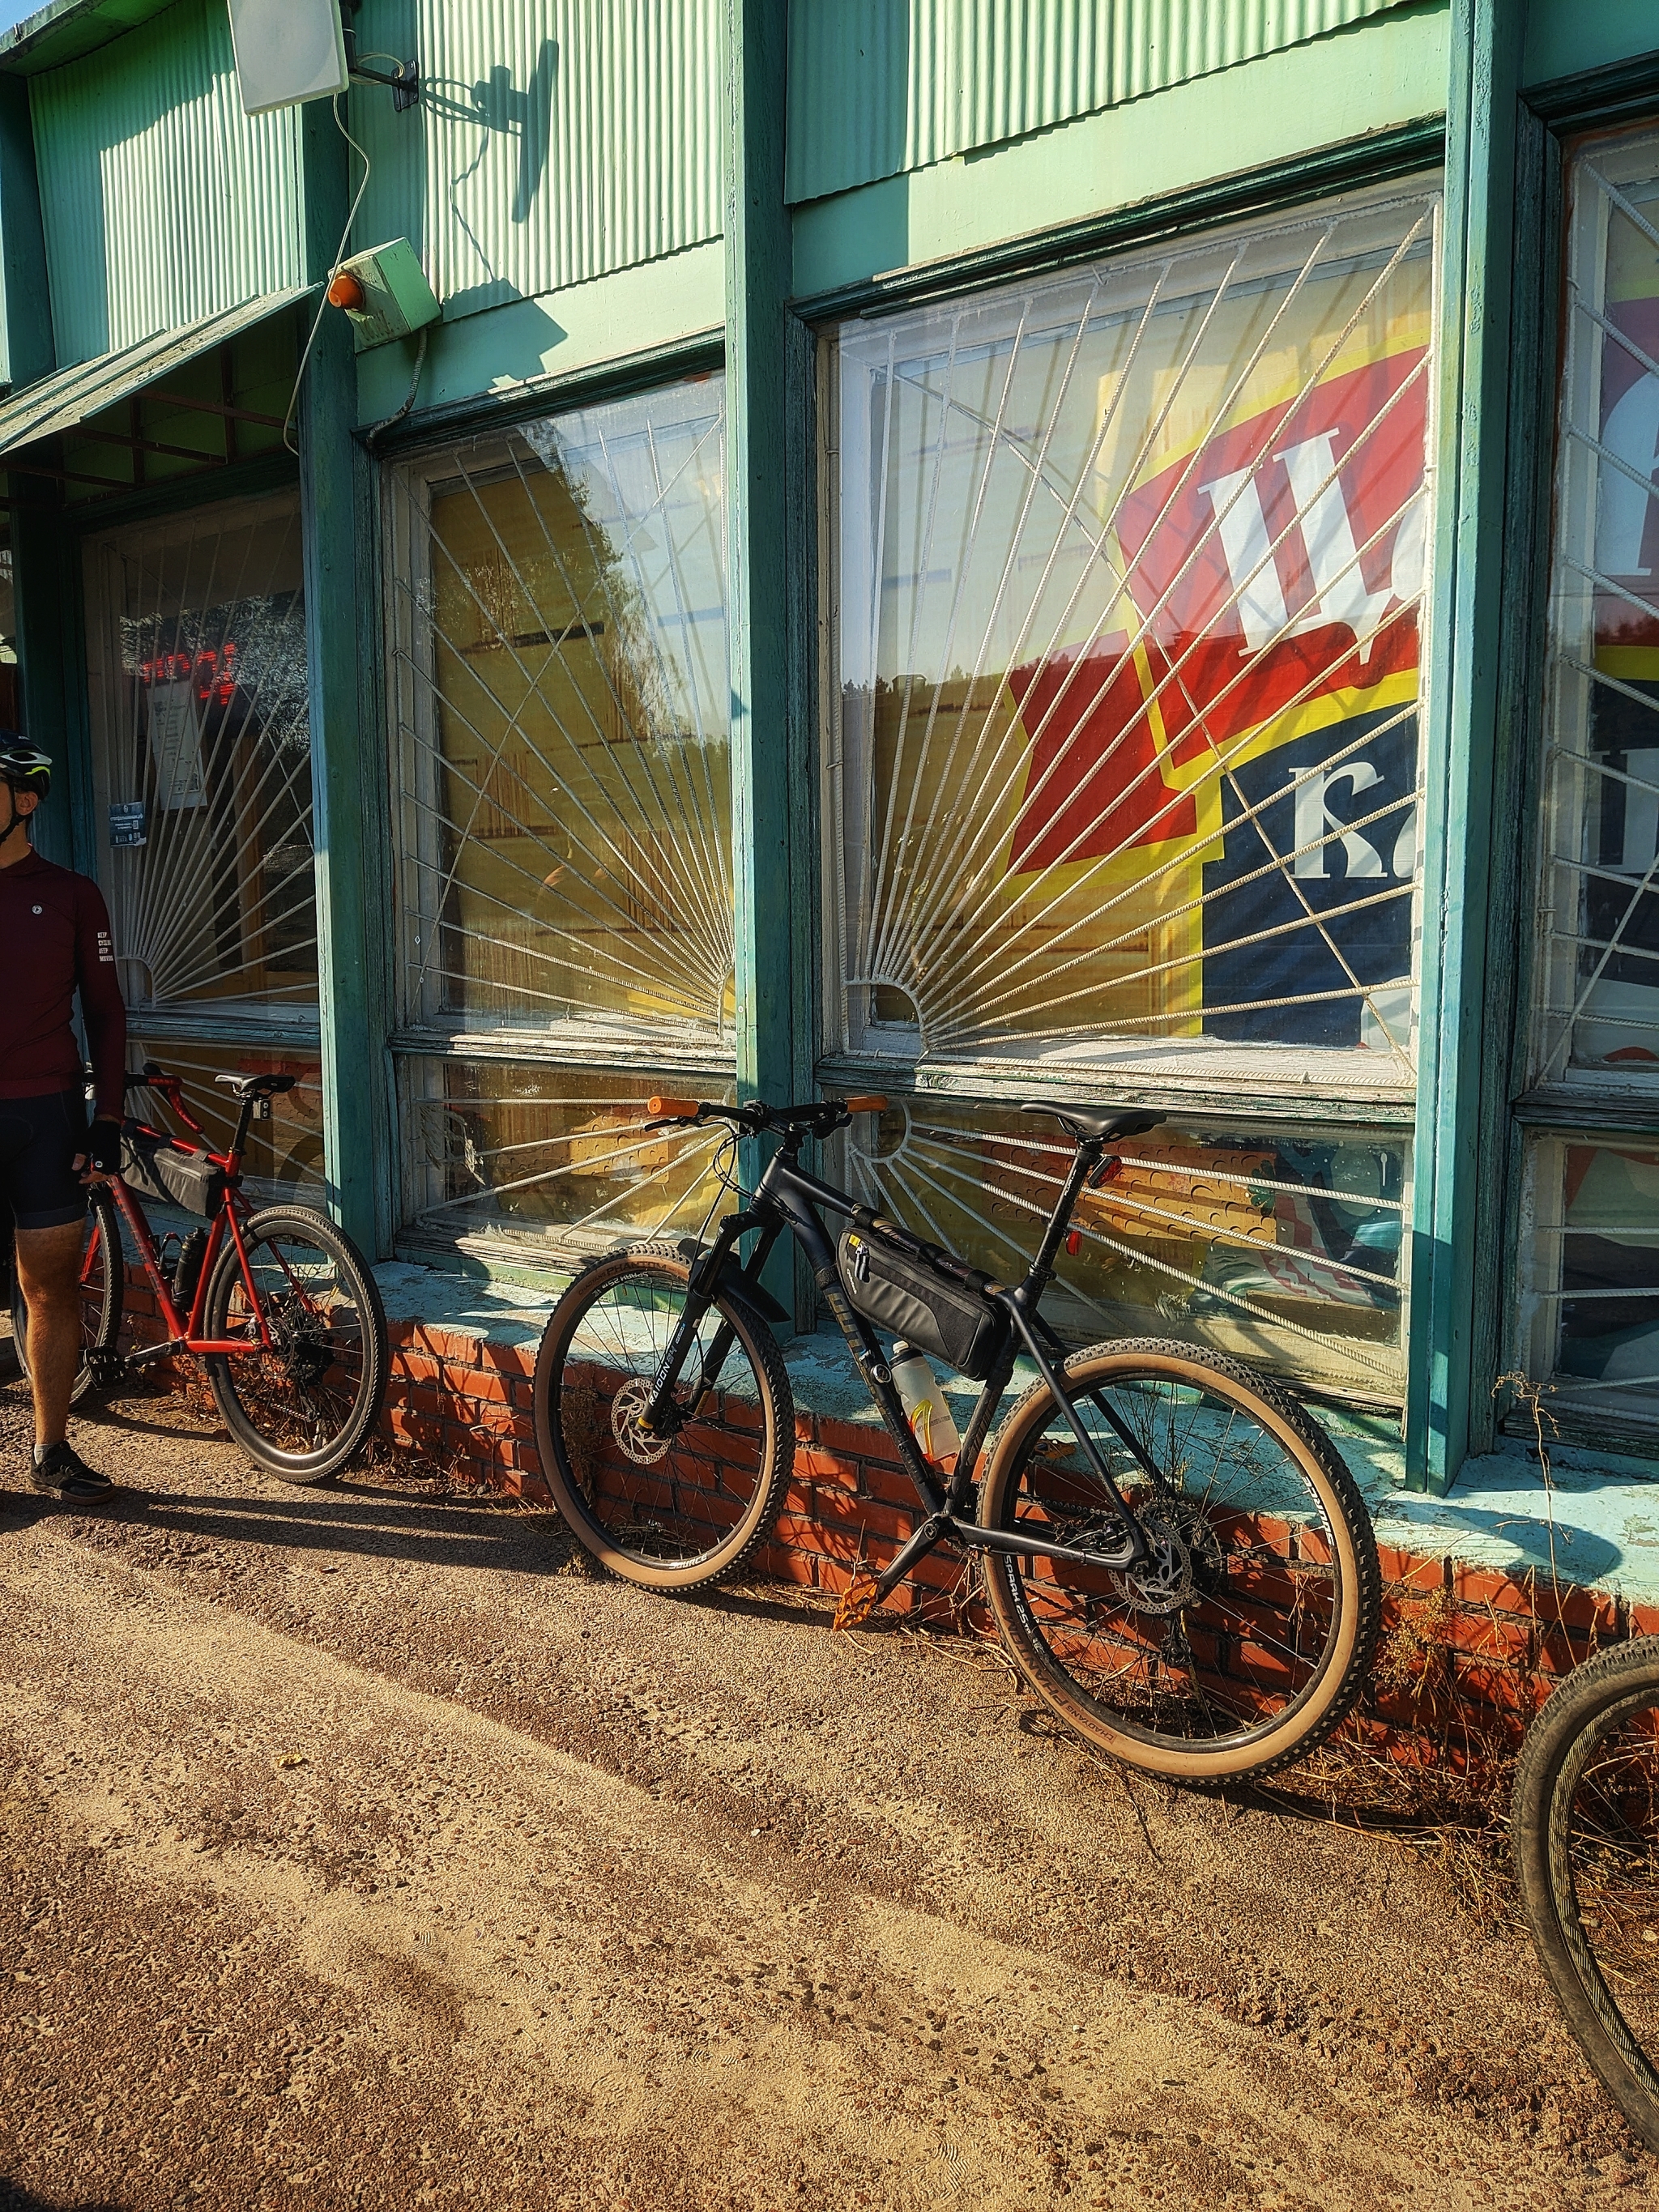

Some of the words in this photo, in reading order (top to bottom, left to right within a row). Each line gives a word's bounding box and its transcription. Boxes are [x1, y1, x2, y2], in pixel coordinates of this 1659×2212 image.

[607, 1261, 666, 1276] PHANTOM
[649, 1362, 672, 1407] RAIDON
[1302, 1476, 1335, 1546] SOURCE
[668, 1552, 708, 1570] SOURCE
[1004, 1615, 1069, 1707] PHANTOM
[1064, 1705, 1115, 1741] CHAOYANG
